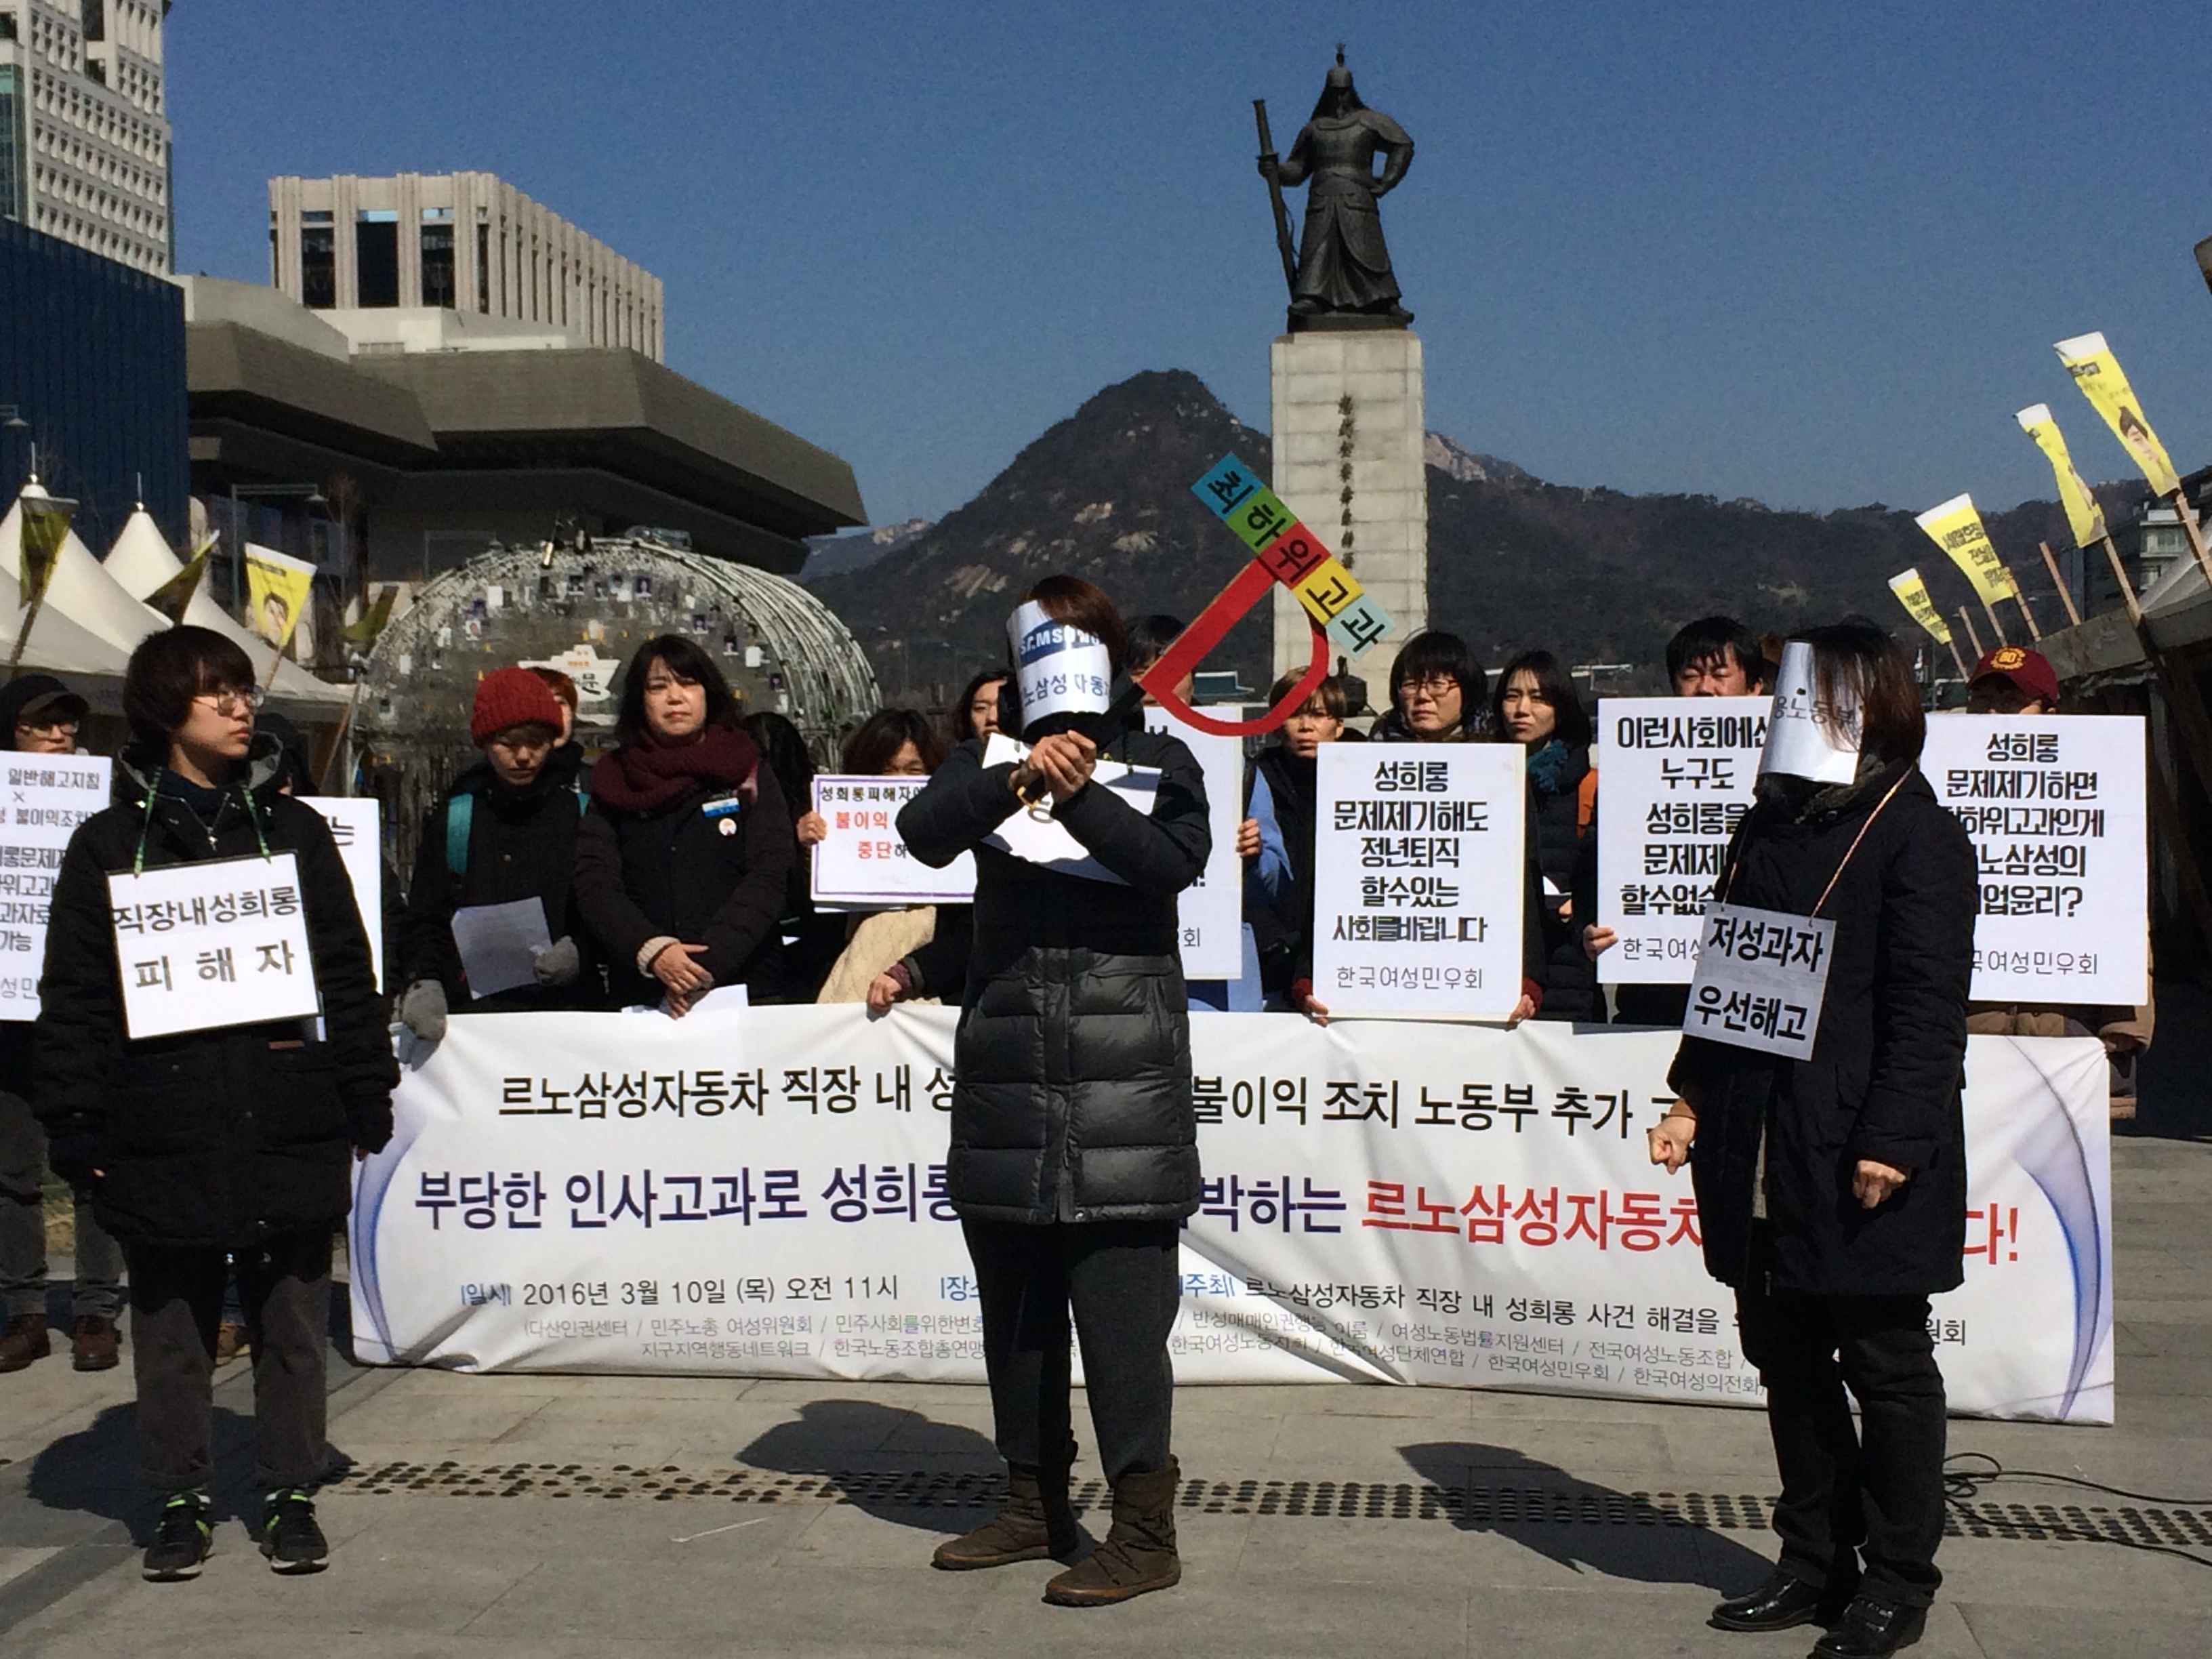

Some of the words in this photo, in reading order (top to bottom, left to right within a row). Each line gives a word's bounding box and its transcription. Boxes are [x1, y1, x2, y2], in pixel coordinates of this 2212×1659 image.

[1207, 470, 1385, 653] 최하위고과
[1023, 674, 1109, 707] 노삼성자동
[1986, 733, 2059, 763] 성희롱
[9, 768, 100, 790] 일반해고지침
[1374, 760, 1449, 793] 성희롱
[1660, 758, 1734, 791] 누구도
[1946, 769, 2098, 801] 문제제기하면
[325, 816, 354, 847] 는
[836, 812, 888, 829] 불이익
[1334, 800, 1489, 833] 문제제기해도
[1943, 806, 2105, 838] 하위고과인게
[0, 846, 65, 869] 롱문제
[1361, 837, 1460, 869] 정년퇴직
[1644, 844, 1728, 876] 문제제
[1979, 844, 2086, 878] 노삼성의
[0, 874, 56, 897] 위고과
[1360, 876, 1459, 907] 할수있는
[1976, 884, 2083, 918] 업윤리?
[112, 886, 300, 934] 직장내성희롱
[1183, 927, 1200, 947] 회
[1332, 915, 1488, 943] 사회를바랍니다
[1708, 916, 1824, 973] 저성과자
[1336, 966, 1483, 990] 한국여성민우회
[1695, 985, 1810, 1042] 우선해고
[499, 1067, 769, 1119] 르노삼성자동차
[781, 1065, 860, 1115] 직장
[876, 1064, 911, 1112] 내
[1191, 1076, 1308, 1125] 불이익
[1322, 1079, 1399, 1130] 조치
[1414, 1082, 1540, 1132] 노동부
[1550, 1086, 1633, 1139] 추가
[415, 1171, 547, 1231] 부당한
[565, 1167, 808, 1229] 인사고과로
[1181, 1174, 1347, 1234] 박하는
[523, 1281, 609, 1307] 2016년
[621, 1279, 659, 1306] 3월
[672, 1279, 726, 1305] 10일
[737, 1277, 775, 1304] (목)
[785, 1275, 833, 1301] 오전
[844, 1274, 899, 1300] 11시
[1246, 1276, 1406, 1310] 르노삼성자동차
[1415, 1287, 1461, 1315] 직장
[1473, 1294, 1493, 1318] 내
[1506, 1296, 1576, 1326] 성희롱
[1587, 1303, 1634, 1330] 사건
[1647, 1305, 1719, 1334] 해결을
[651, 1317, 718, 1338] 민주노총
[726, 1315, 812, 1337] 여성위원회
[836, 1314, 983, 1335] 민주사회를위한변호
[1589, 1340, 1733, 1369] 전국여성노동조합
[1489, 1353, 1609, 1381] 한국여성민우회
